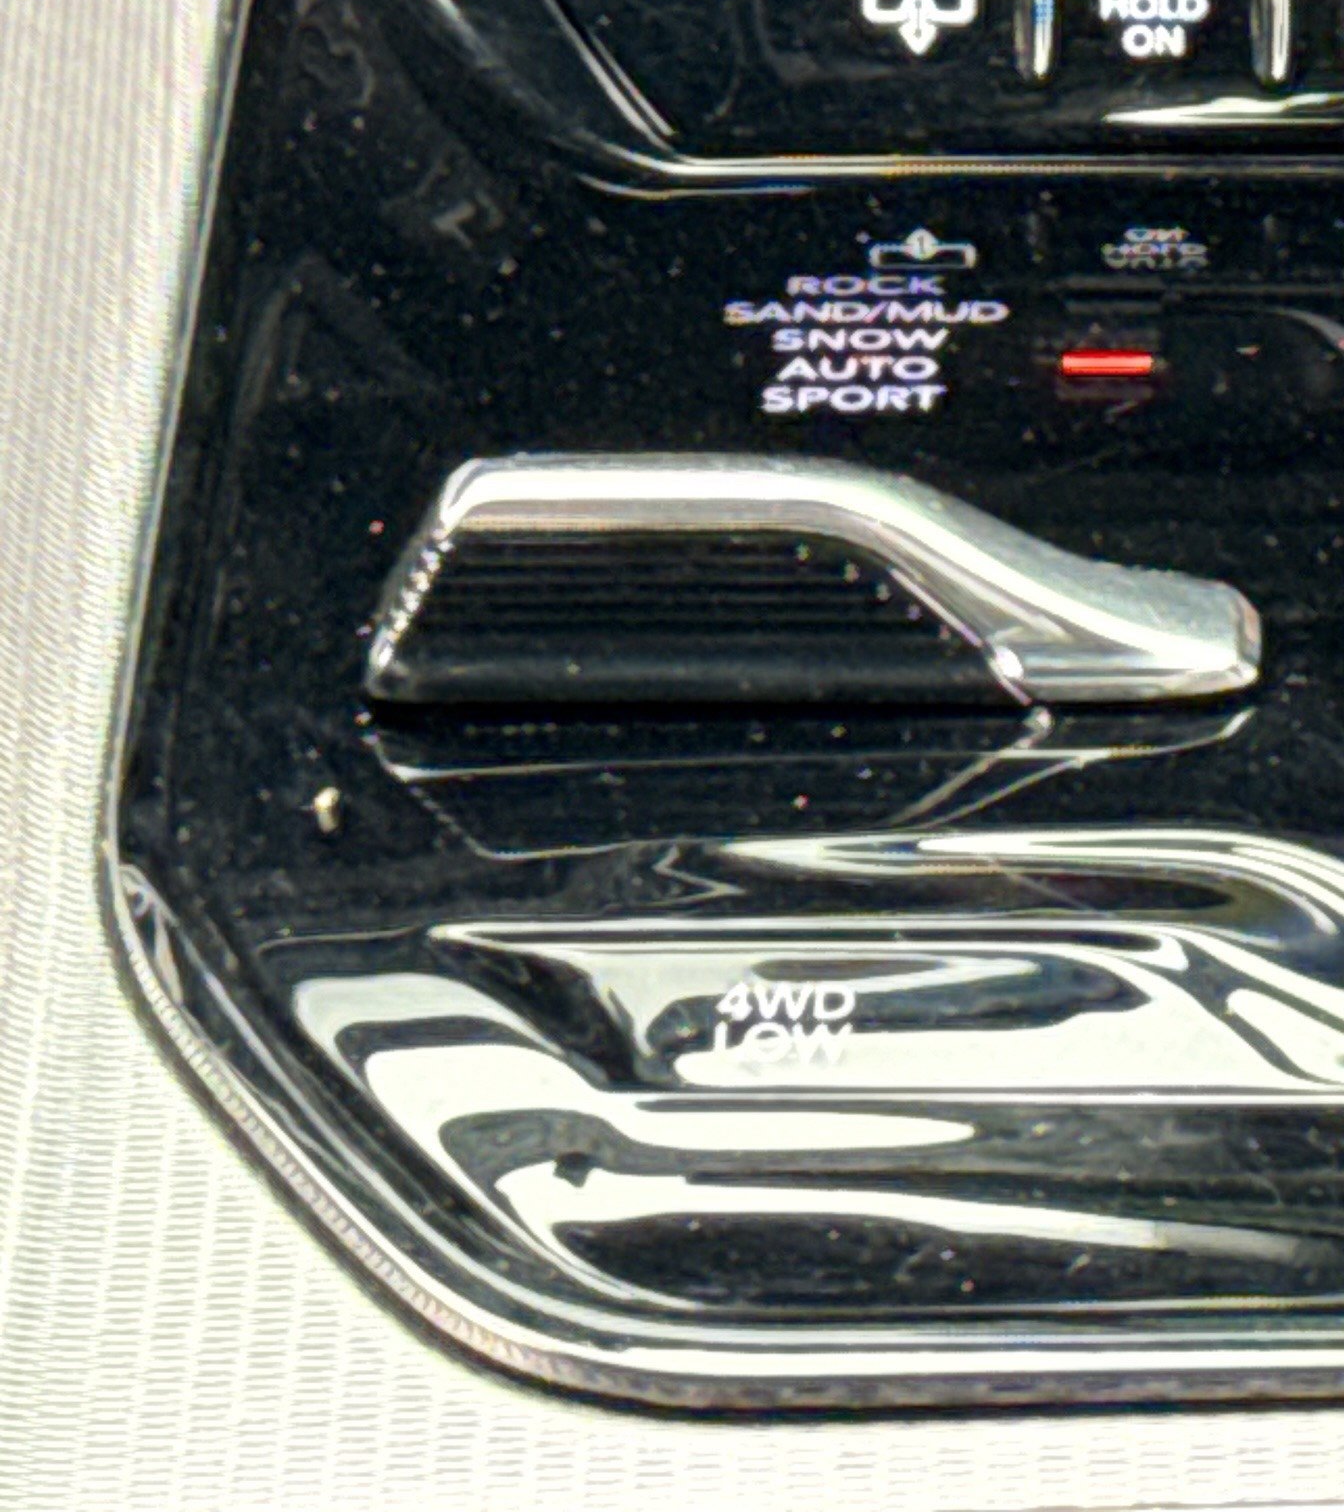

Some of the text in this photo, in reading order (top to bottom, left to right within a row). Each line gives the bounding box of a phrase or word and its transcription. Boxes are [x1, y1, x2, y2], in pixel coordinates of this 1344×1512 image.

[1122, 26, 1186, 57] ON
[787, 276, 946, 296] ROCK
[724, 302, 1012, 325] SAND/MUD
[772, 328, 949, 351] SNOW
[777, 356, 940, 381] AUTO
[761, 385, 948, 413] SPORT
[716, 983, 856, 1020] 4WD
